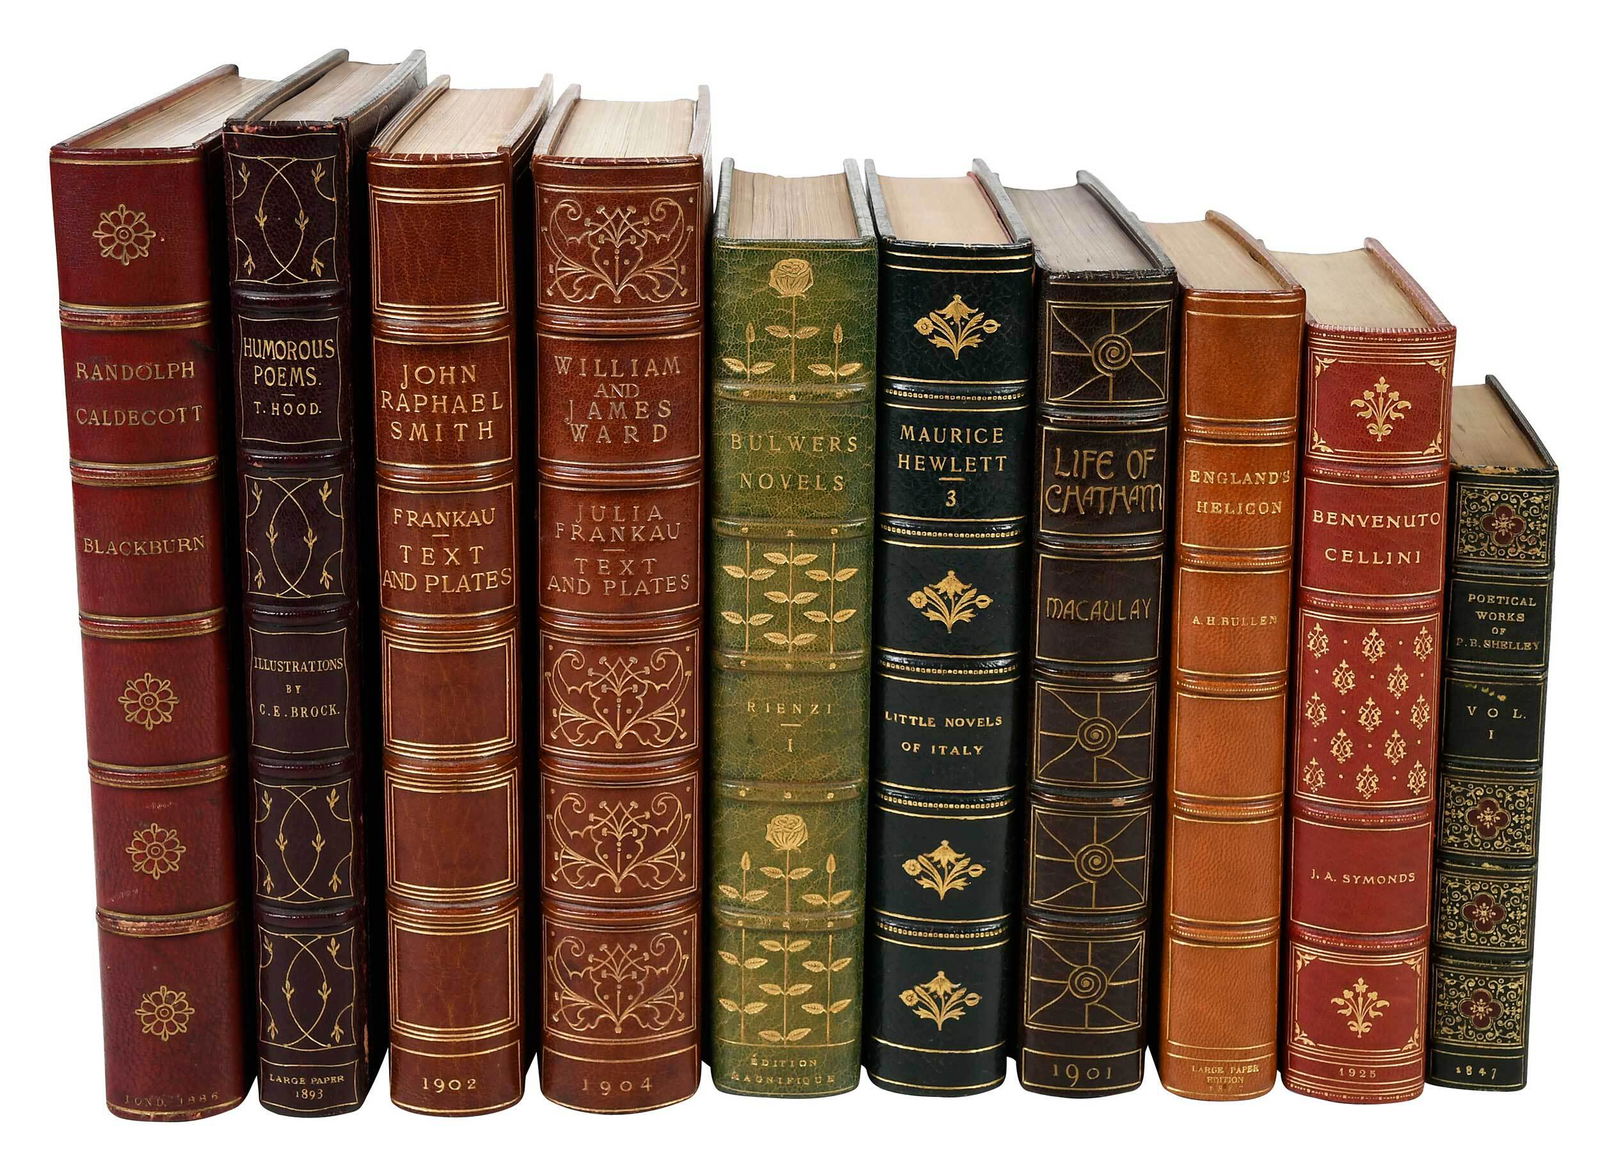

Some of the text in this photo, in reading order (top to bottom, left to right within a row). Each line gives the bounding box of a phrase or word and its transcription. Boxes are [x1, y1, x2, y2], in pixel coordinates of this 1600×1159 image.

[243, 337, 335, 361] HUMOROUS
[76, 361, 195, 381] RANDOLPH
[554, 355, 681, 378] WILLIAM
[253, 365, 322, 387] POEMS.
[400, 364, 477, 389] JOHN
[595, 383, 640, 398] AND
[253, 401, 322, 416] T. HOOD.
[381, 390, 504, 414] RAPHAEL
[76, 405, 203, 427] CALDECOTT
[564, 400, 672, 424] JAMES
[390, 420, 494, 442] SMITH
[570, 424, 668, 444] WARD
[900, 424, 1004, 444] MAURICE
[730, 434, 857, 453] BULWERS
[897, 454, 1007, 473] HEWLETT
[1053, 448, 1156, 480] LIFE OF
[740, 473, 845, 491] NOVELS
[1189, 469, 1291, 485] ENGLAND'S
[945, 490, 957, 508] 3
[1045, 484, 1164, 515] CHATHAM
[1196, 500, 1283, 515] HELICON
[393, 507, 496, 528] FRANKAU
[575, 505, 663, 523] JULIA
[1312, 510, 1441, 529] BENVENUTO
[555, 522, 680, 543] FRANKAU
[83, 536, 205, 556] BLACKBURN
[399, 545, 484, 566] TEXT
[1324, 548, 1421, 565] CELLINI
[575, 557, 657, 576] TEXT
[382, 567, 512, 593] AND PLATES
[547, 573, 690, 597] AND PLATES
[1467, 593, 1537, 607] POETICAL
[1046, 598, 1152, 621] MACAULAY
[1475, 610, 1525, 622] WORKS
[1491, 627, 1507, 636] OF
[254, 656, 344, 673] ILLUSTRATIONS
[286, 684, 301, 694] BY
[747, 701, 832, 715] RIENZI
[1466, 706, 1527, 719] VOL.
[884, 711, 1003, 728] LITTLE NOVELS
[1488, 731, 1495, 740] I
[901, 741, 984, 756] OF ITALY
[1310, 868, 1416, 885] J. A. SYMONDS
[1052, 1063, 1113, 1088] 1901
[1192, 1064, 1260, 1074] LARGE PAPER
[1339, 1068, 1377, 1079] 1925
[1455, 1065, 1498, 1080] 1847
[269, 1073, 345, 1085] LARGE PAPER
[422, 1077, 477, 1093] 1902
[581, 1076, 653, 1096] 1904
[1207, 1076, 1245, 1084] EDITION
[296, 1088, 323, 1100] 1893
